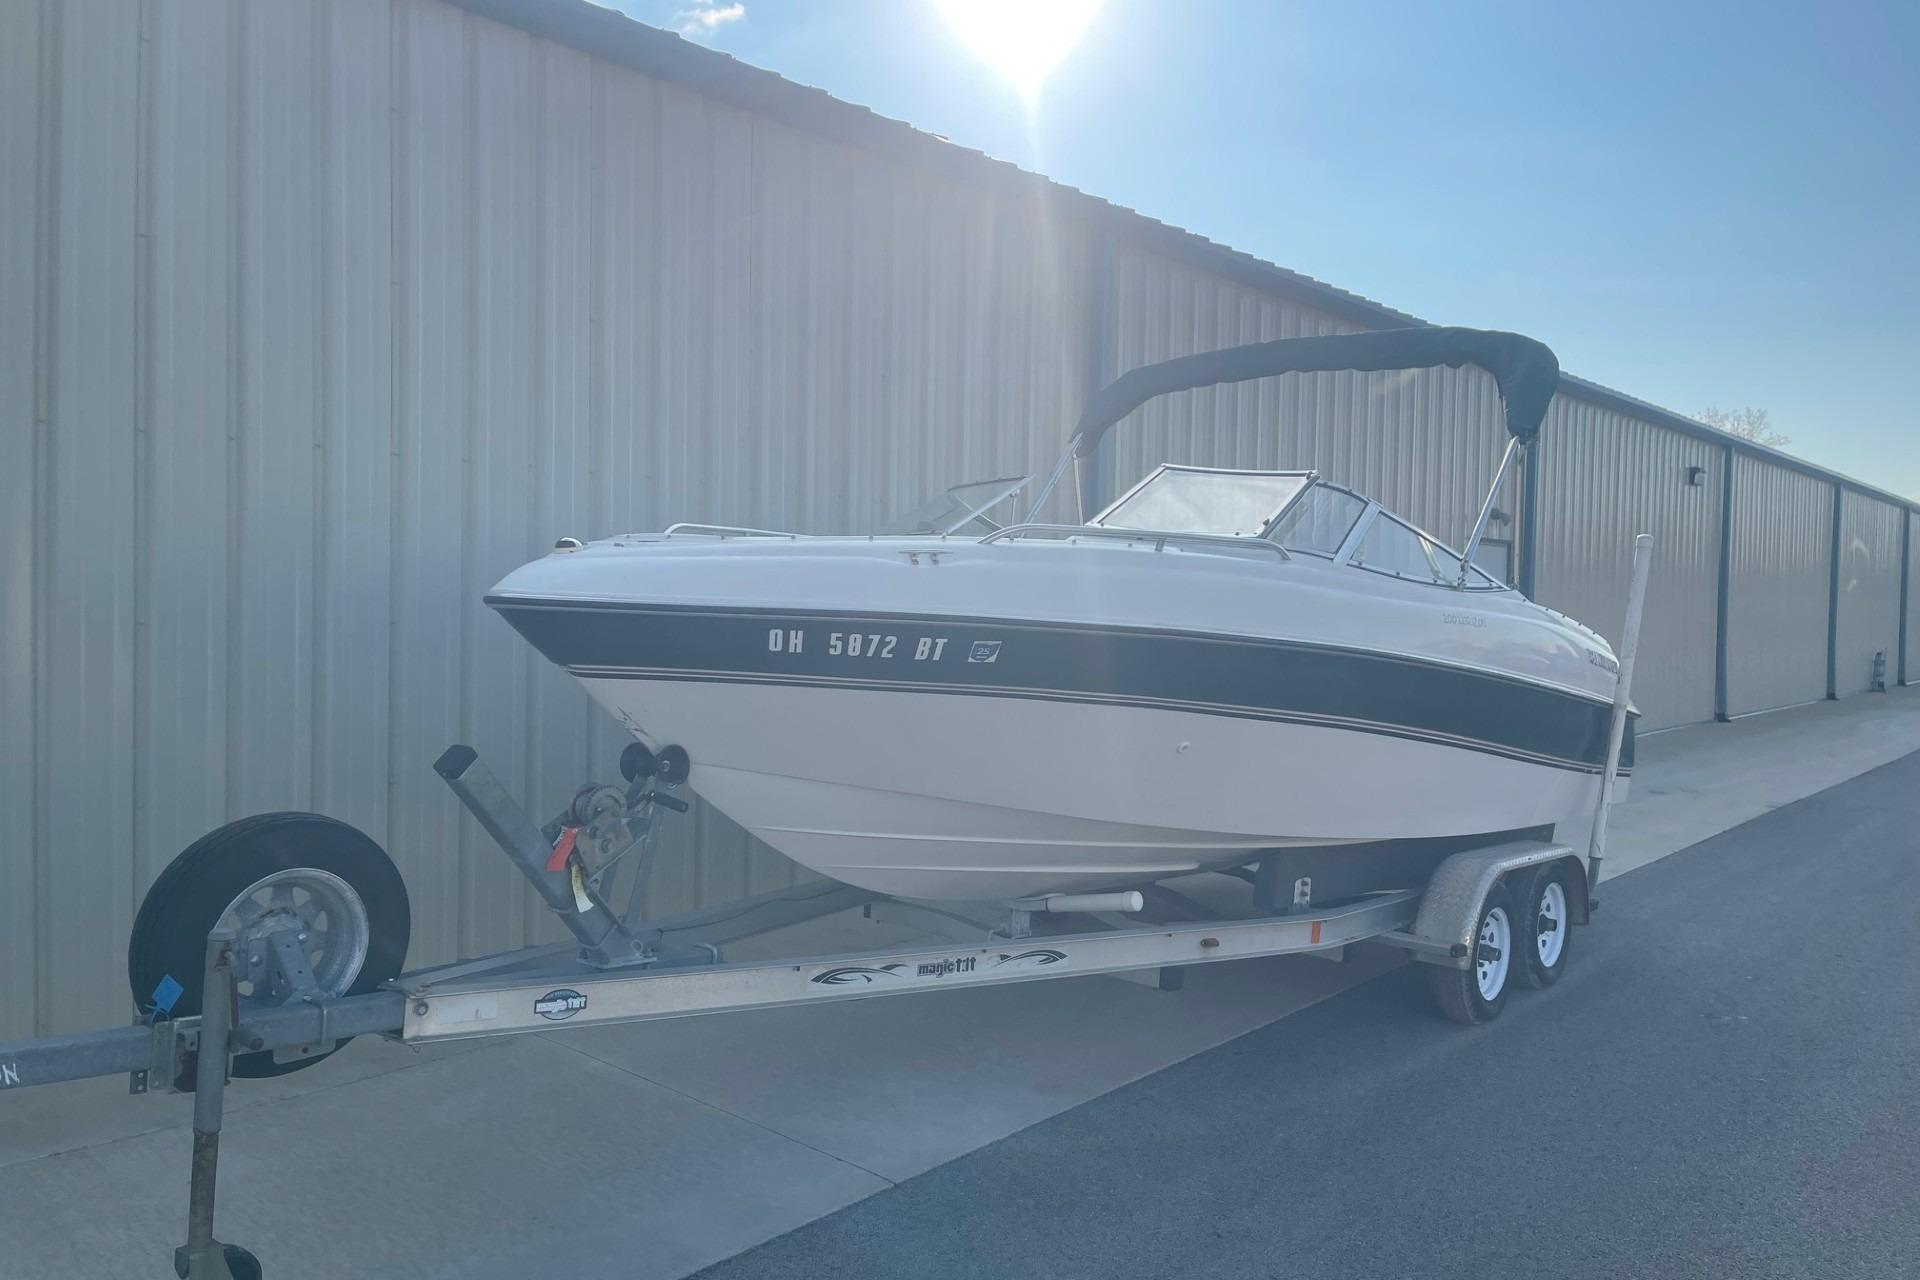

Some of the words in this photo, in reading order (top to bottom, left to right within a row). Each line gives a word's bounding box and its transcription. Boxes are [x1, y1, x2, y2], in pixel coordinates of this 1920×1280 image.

[768, 629, 804, 653] OH
[829, 632, 898, 658] 5872
[914, 637, 948, 661] BT
